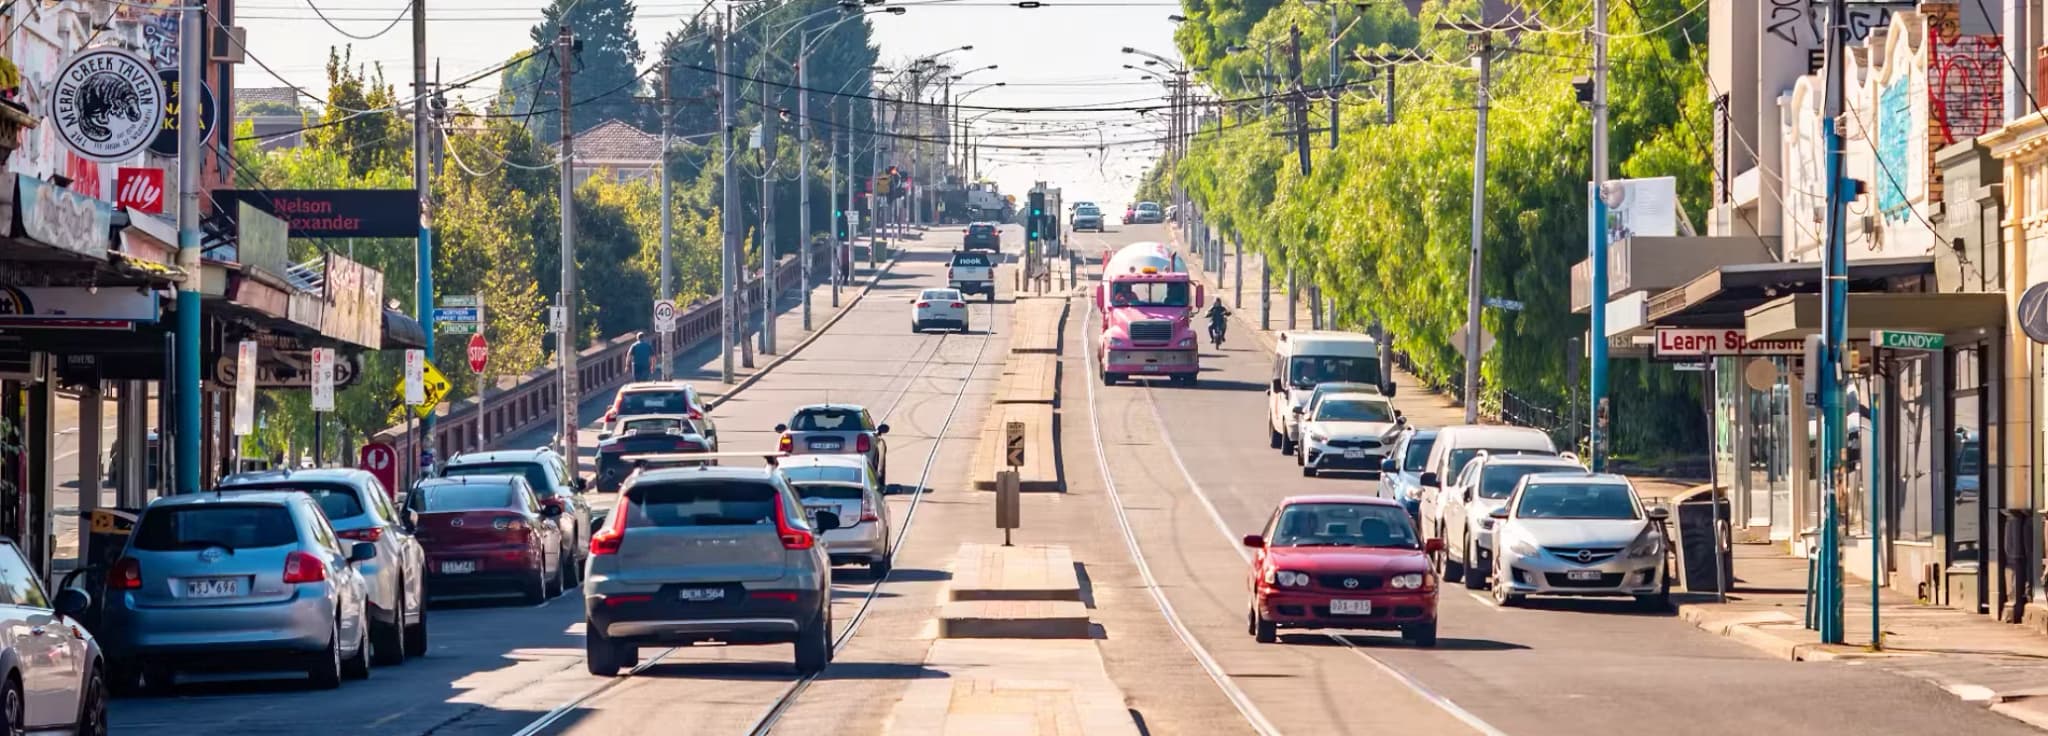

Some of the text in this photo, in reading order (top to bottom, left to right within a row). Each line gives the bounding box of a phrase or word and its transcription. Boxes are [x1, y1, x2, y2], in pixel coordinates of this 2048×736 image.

[71, 56, 114, 83] CREEK
[117, 58, 155, 106] TAVERN
[58, 83, 78, 128] MERRI
[69, 129, 88, 148] THE
[120, 174, 161, 209] illy
[272, 197, 333, 214] Nelson
[275, 214, 361, 231] lexander
[657, 307, 671, 317] 40
[1661, 331, 1716, 351] Learn
[1889, 334, 1933, 348] CANDY
[468, 346, 488, 361] STOP
